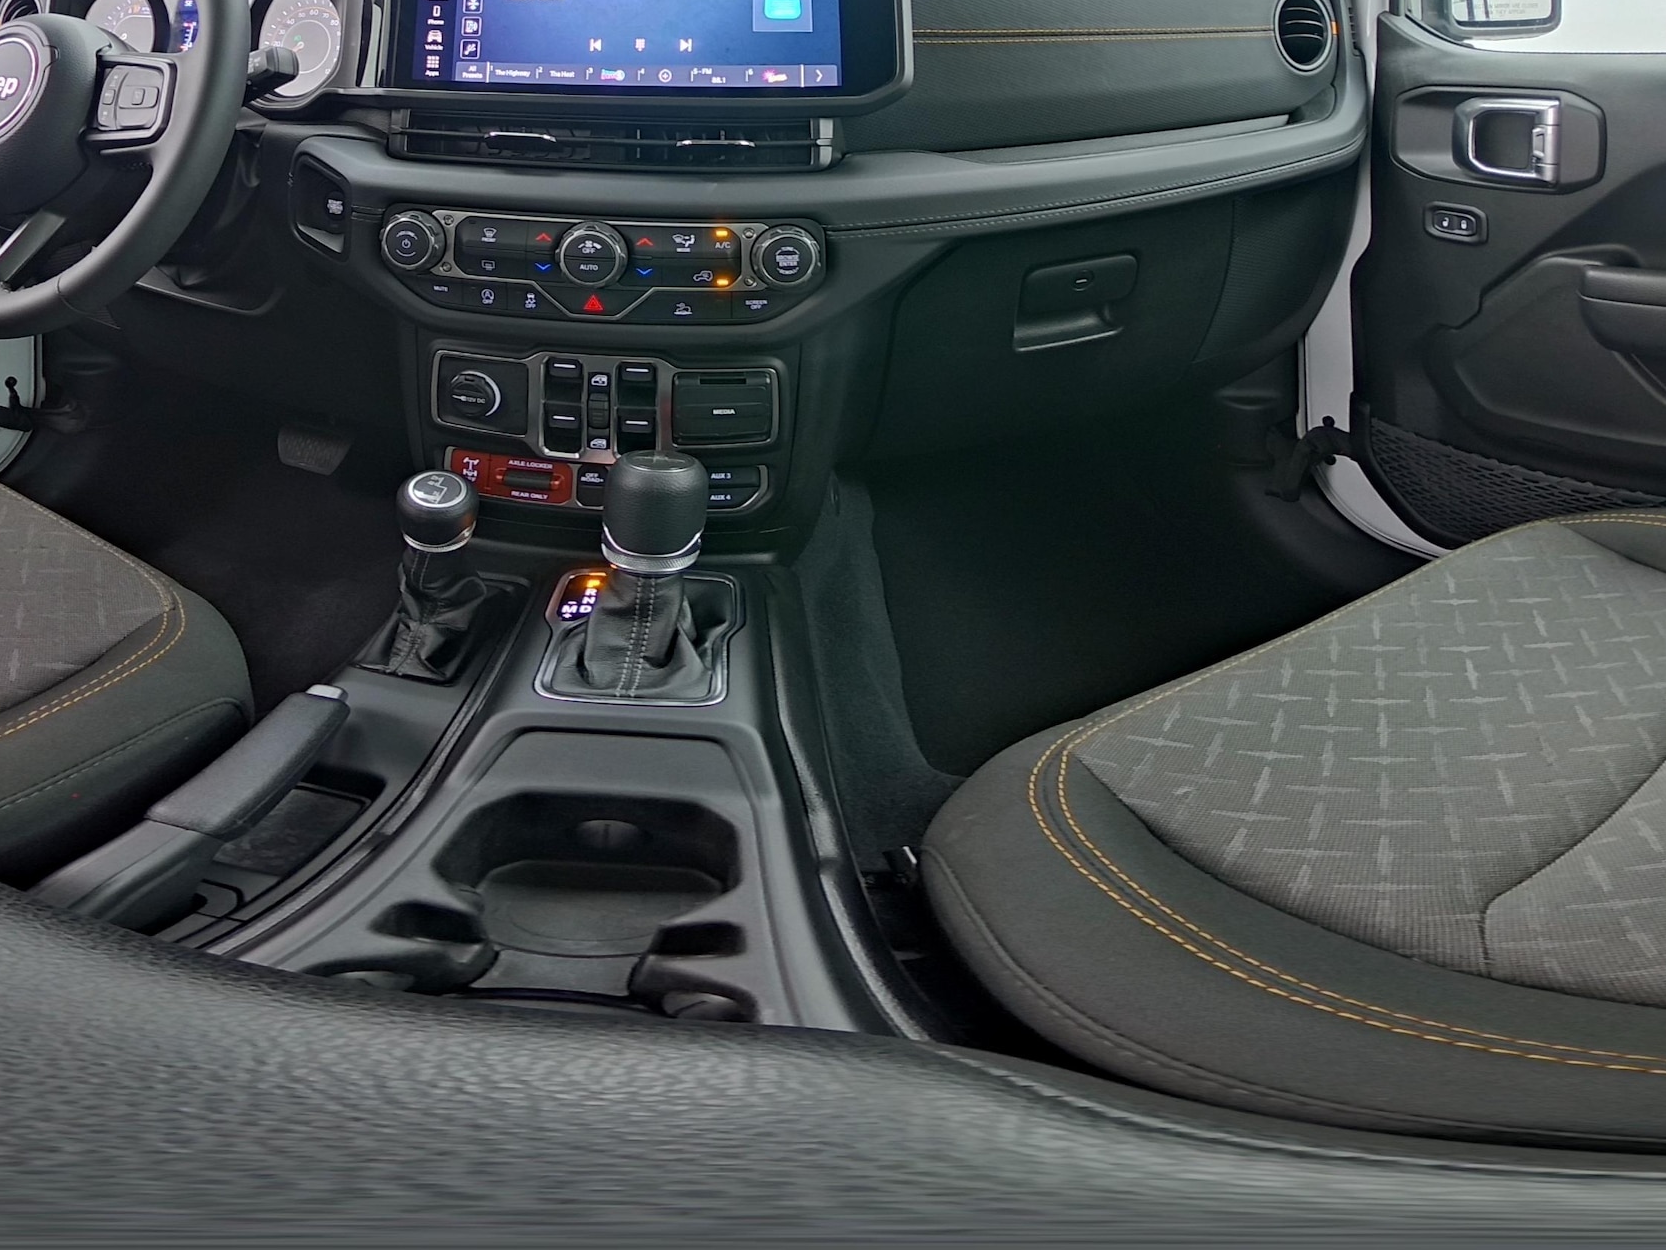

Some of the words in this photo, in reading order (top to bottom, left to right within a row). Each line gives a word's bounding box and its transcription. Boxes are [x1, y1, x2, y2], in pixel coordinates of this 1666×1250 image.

[715, 241, 731, 249] A/C
[579, 263, 599, 271] AUTO
[508, 459, 526, 468] AXLE
[526, 460, 554, 470] LOCKER
[511, 490, 528, 498] REAR
[528, 492, 549, 501] ONLY
[585, 579, 600, 588] P
[584, 588, 598, 596] R
[581, 596, 596, 604] N
[561, 604, 578, 613] M
[578, 605, 592, 613] D
